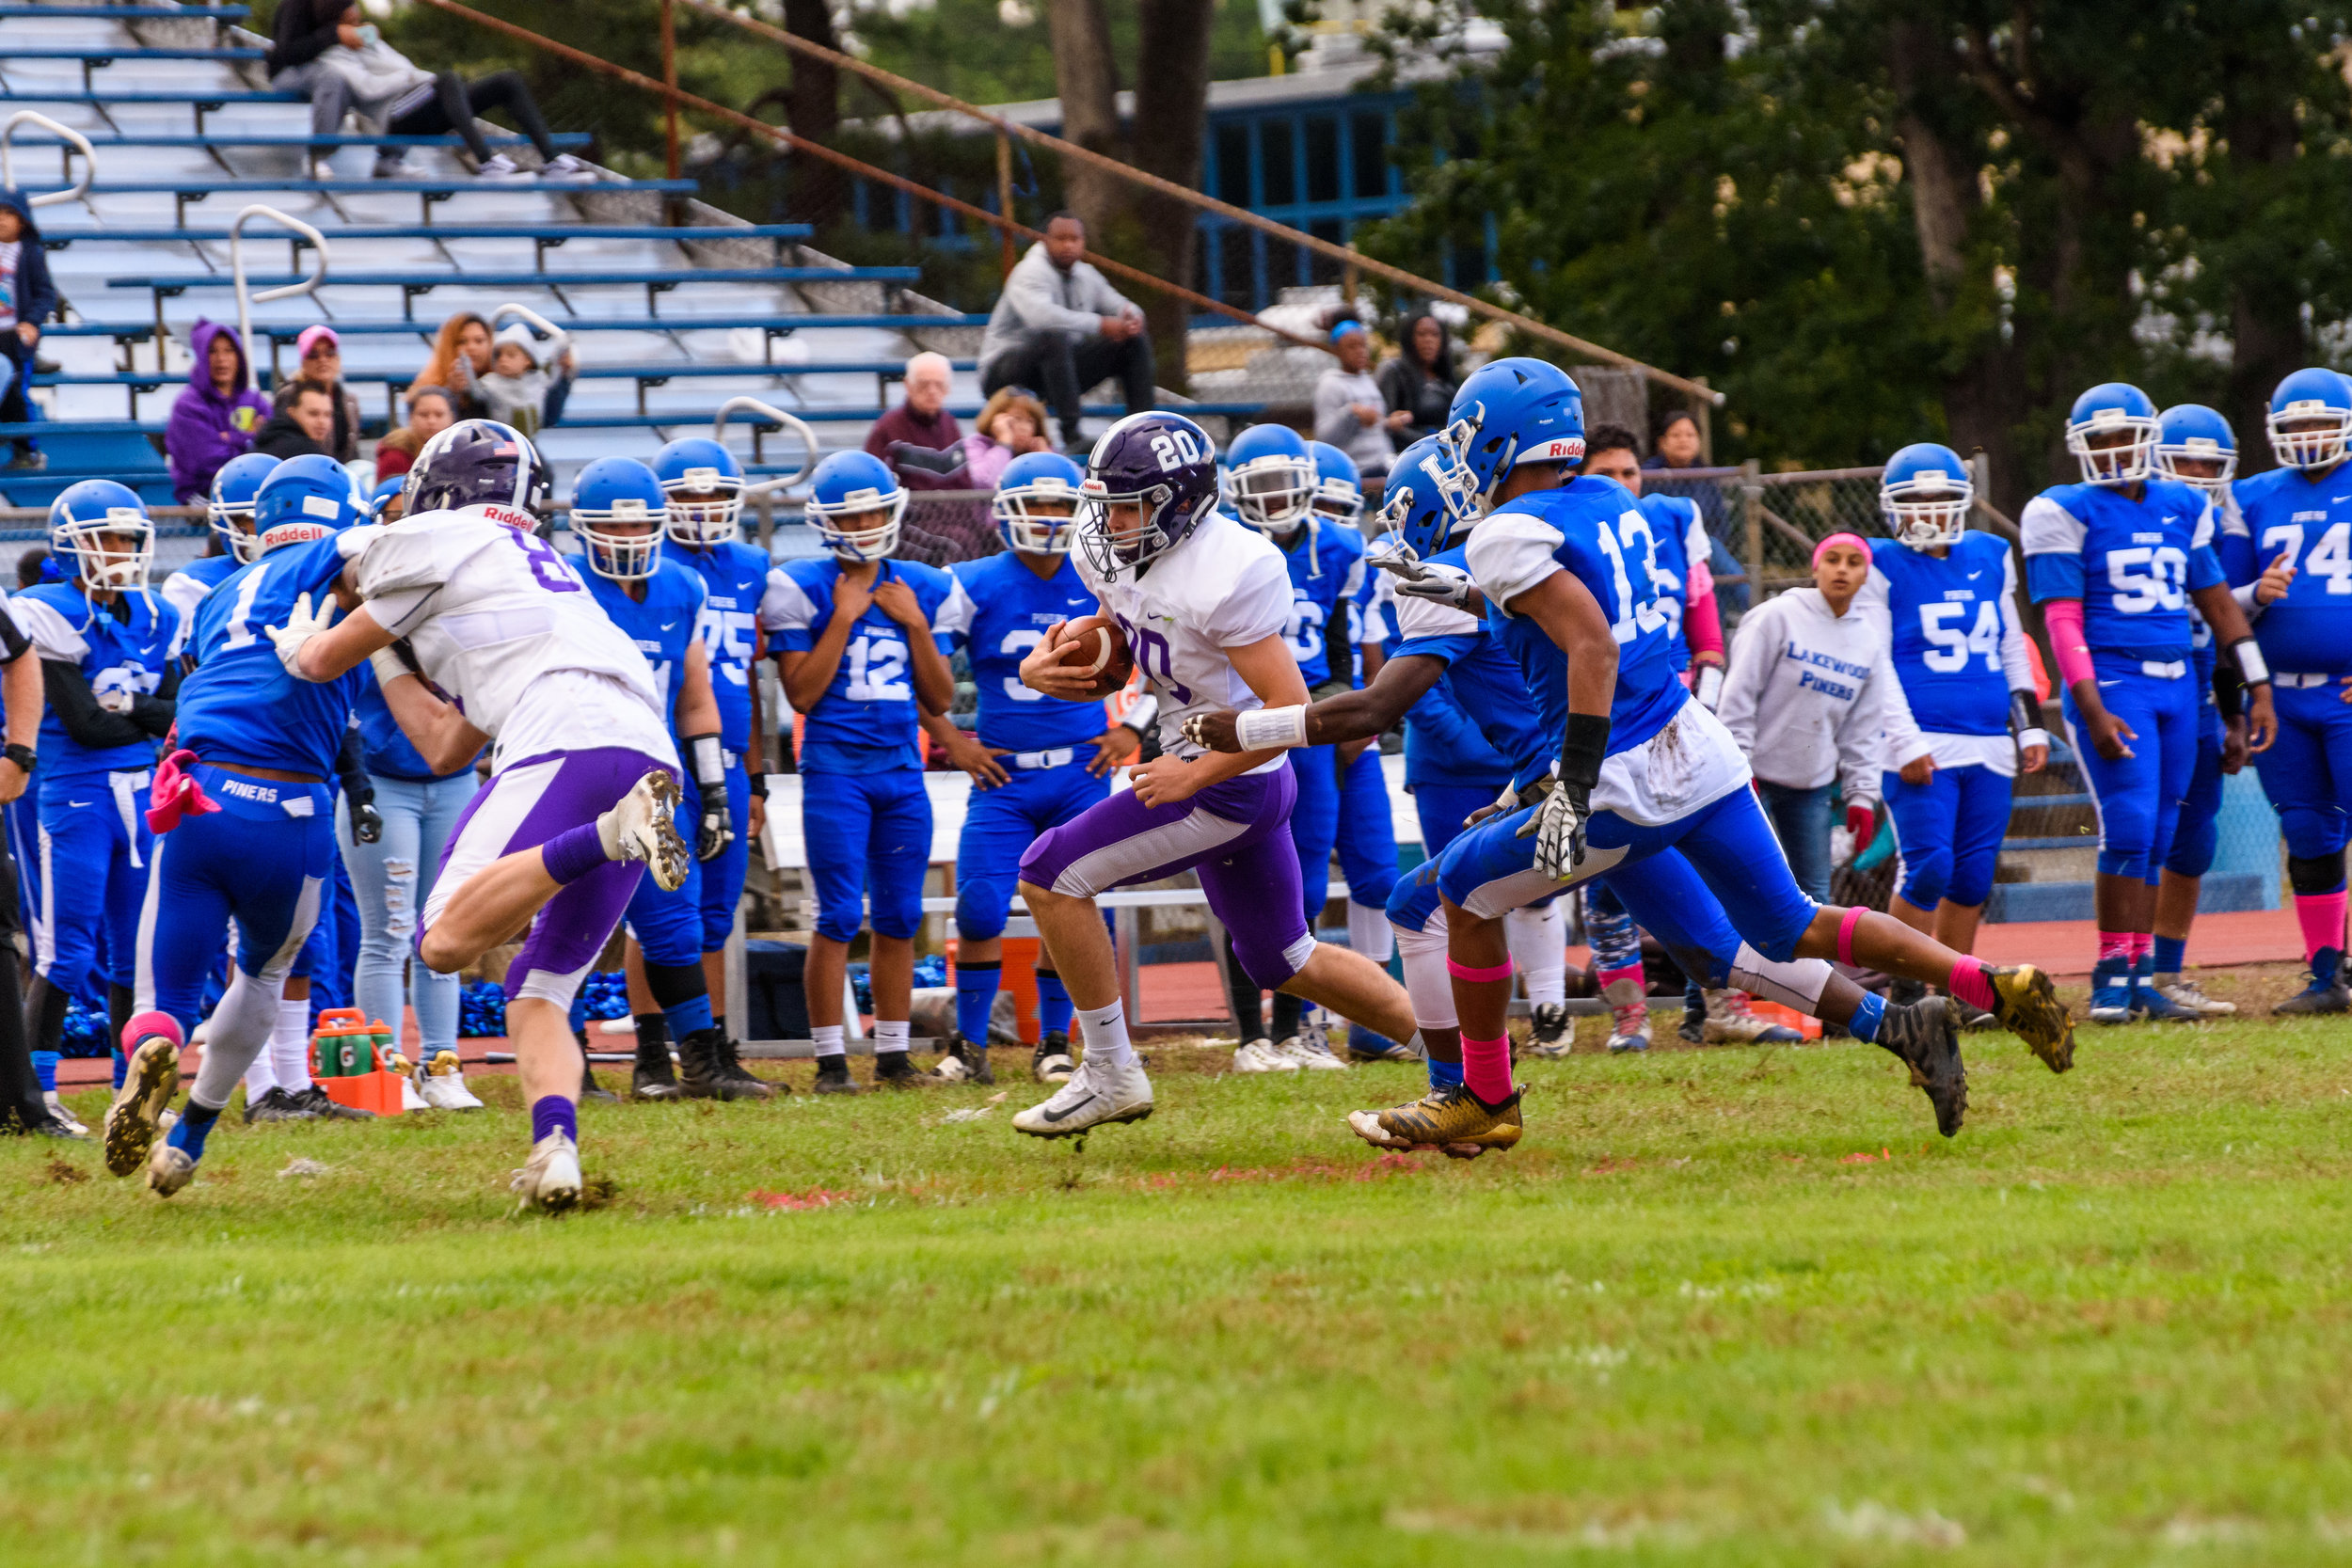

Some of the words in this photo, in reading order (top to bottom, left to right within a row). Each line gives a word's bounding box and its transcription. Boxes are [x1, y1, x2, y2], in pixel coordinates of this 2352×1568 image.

[1151, 430, 1200, 472] 20
[264, 527, 323, 547] Riddell
[484, 507, 534, 532] Riddell
[1597, 509, 1668, 645] 13
[2106, 546, 2187, 614] 50
[2262, 522, 2352, 594] 74
[221, 562, 271, 651] 1
[1919, 600, 2002, 673] 54
[846, 636, 913, 701] 12
[1799, 670, 1854, 701] PINERS
[221, 779, 278, 803] PINERS
